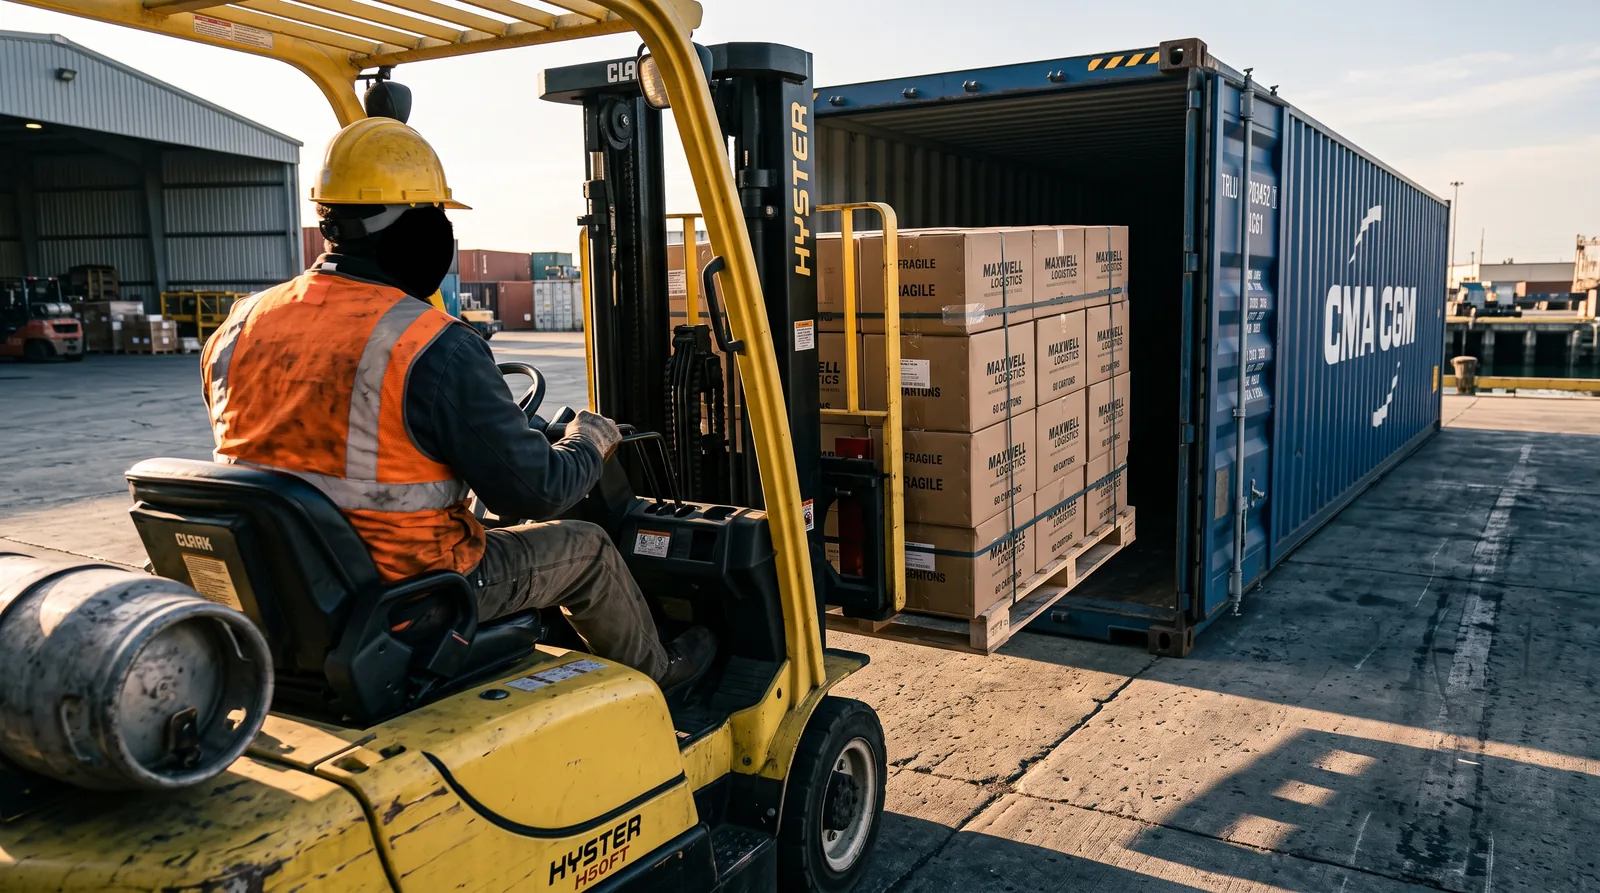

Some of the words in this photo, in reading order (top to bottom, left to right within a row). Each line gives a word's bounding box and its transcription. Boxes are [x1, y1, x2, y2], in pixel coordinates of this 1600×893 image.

[607, 61, 637, 83] CLA
[791, 101, 811, 276] HYSTER
[1221, 173, 1239, 199] TRLU
[898, 258, 936, 270] FRAGILE
[1044, 255, 1078, 270] MAXWELL
[898, 284, 936, 297] AGILE
[991, 275, 1023, 289] LOGSTICS
[1324, 284, 1375, 365] CMA
[1379, 286, 1417, 352] CGM
[1048, 337, 1080, 357] MAXWELL
[995, 367, 1026, 385] LOGSTICS
[1049, 416, 1080, 441] MAXWELL
[1054, 429, 1079, 449] LOGISTICS
[904, 452, 943, 465] FRAGILE
[903, 476, 943, 491] RAGILE
[174, 532, 213, 552] CLARK
[548, 813, 642, 886] HYSTER
[574, 845, 630, 890] H50FT
